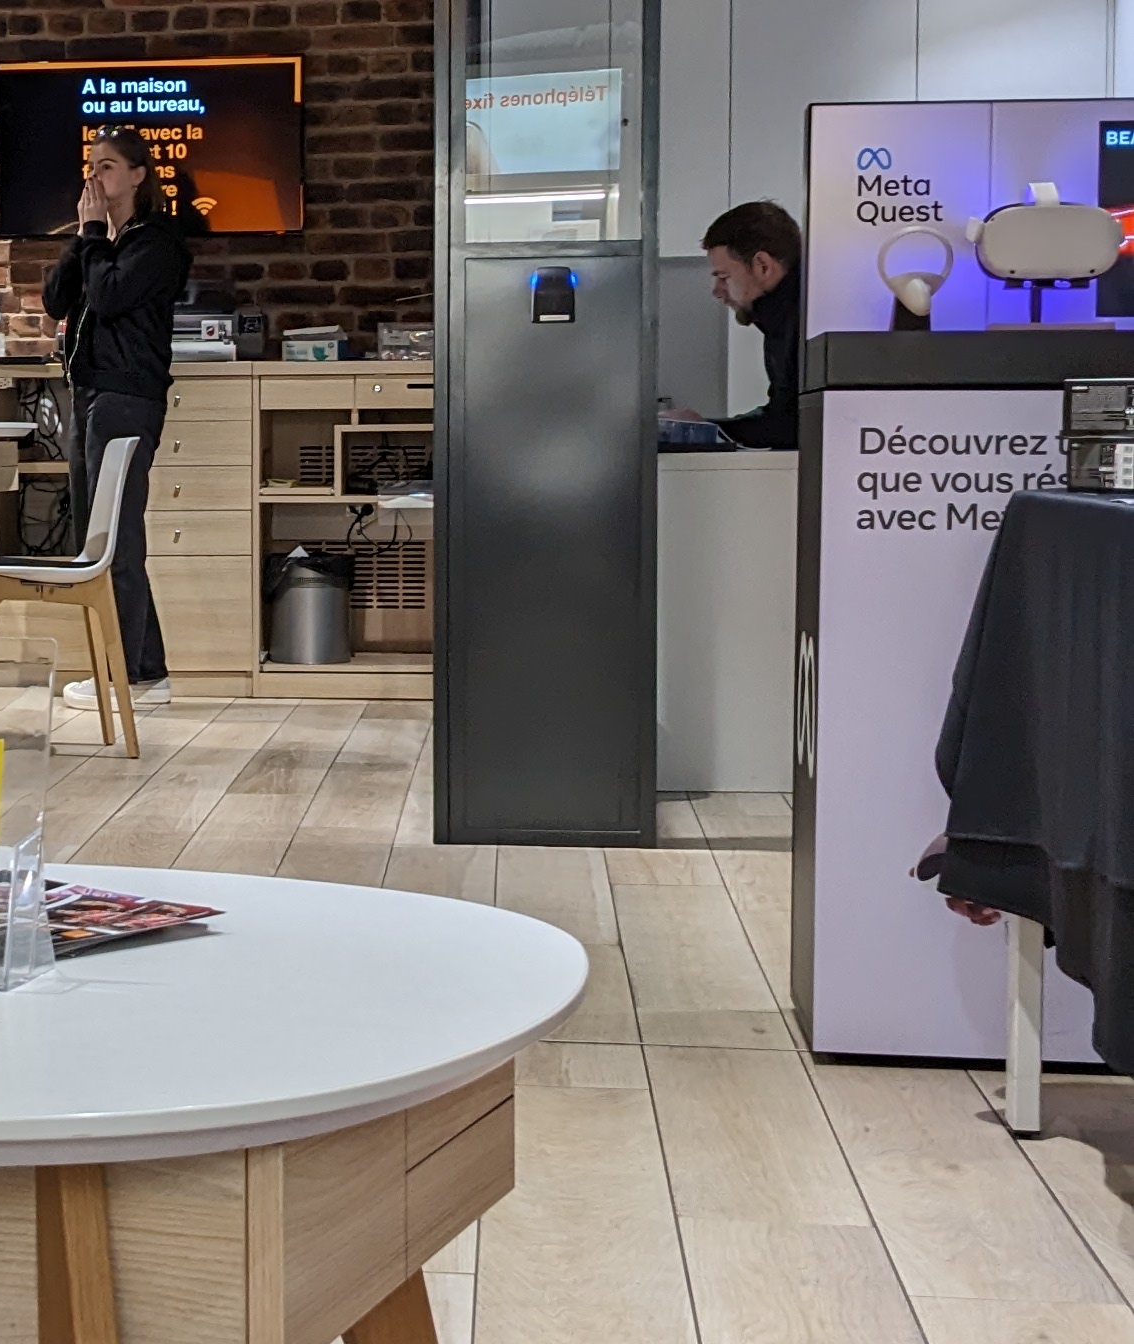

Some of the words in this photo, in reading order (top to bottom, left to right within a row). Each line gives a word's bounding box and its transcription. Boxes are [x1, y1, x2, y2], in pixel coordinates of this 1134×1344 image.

[82, 79, 97, 94] A
[100, 78, 116, 94] la
[121, 78, 187, 93] maison
[82, 101, 105, 113] ou
[110, 100, 132, 113] au
[137, 97, 206, 114] bureau,
[139, 127, 183, 140] avec
[187, 124, 204, 140] la
[166, 143, 187, 159] 10
[857, 175, 930, 196] Meta
[856, 200, 943, 226] Quest
[860, 425, 1047, 455] Découvrez
[857, 471, 922, 500] que
[931, 471, 1013, 493] vous
[857, 509, 936, 531] avec
[947, 503, 1006, 531] Me
